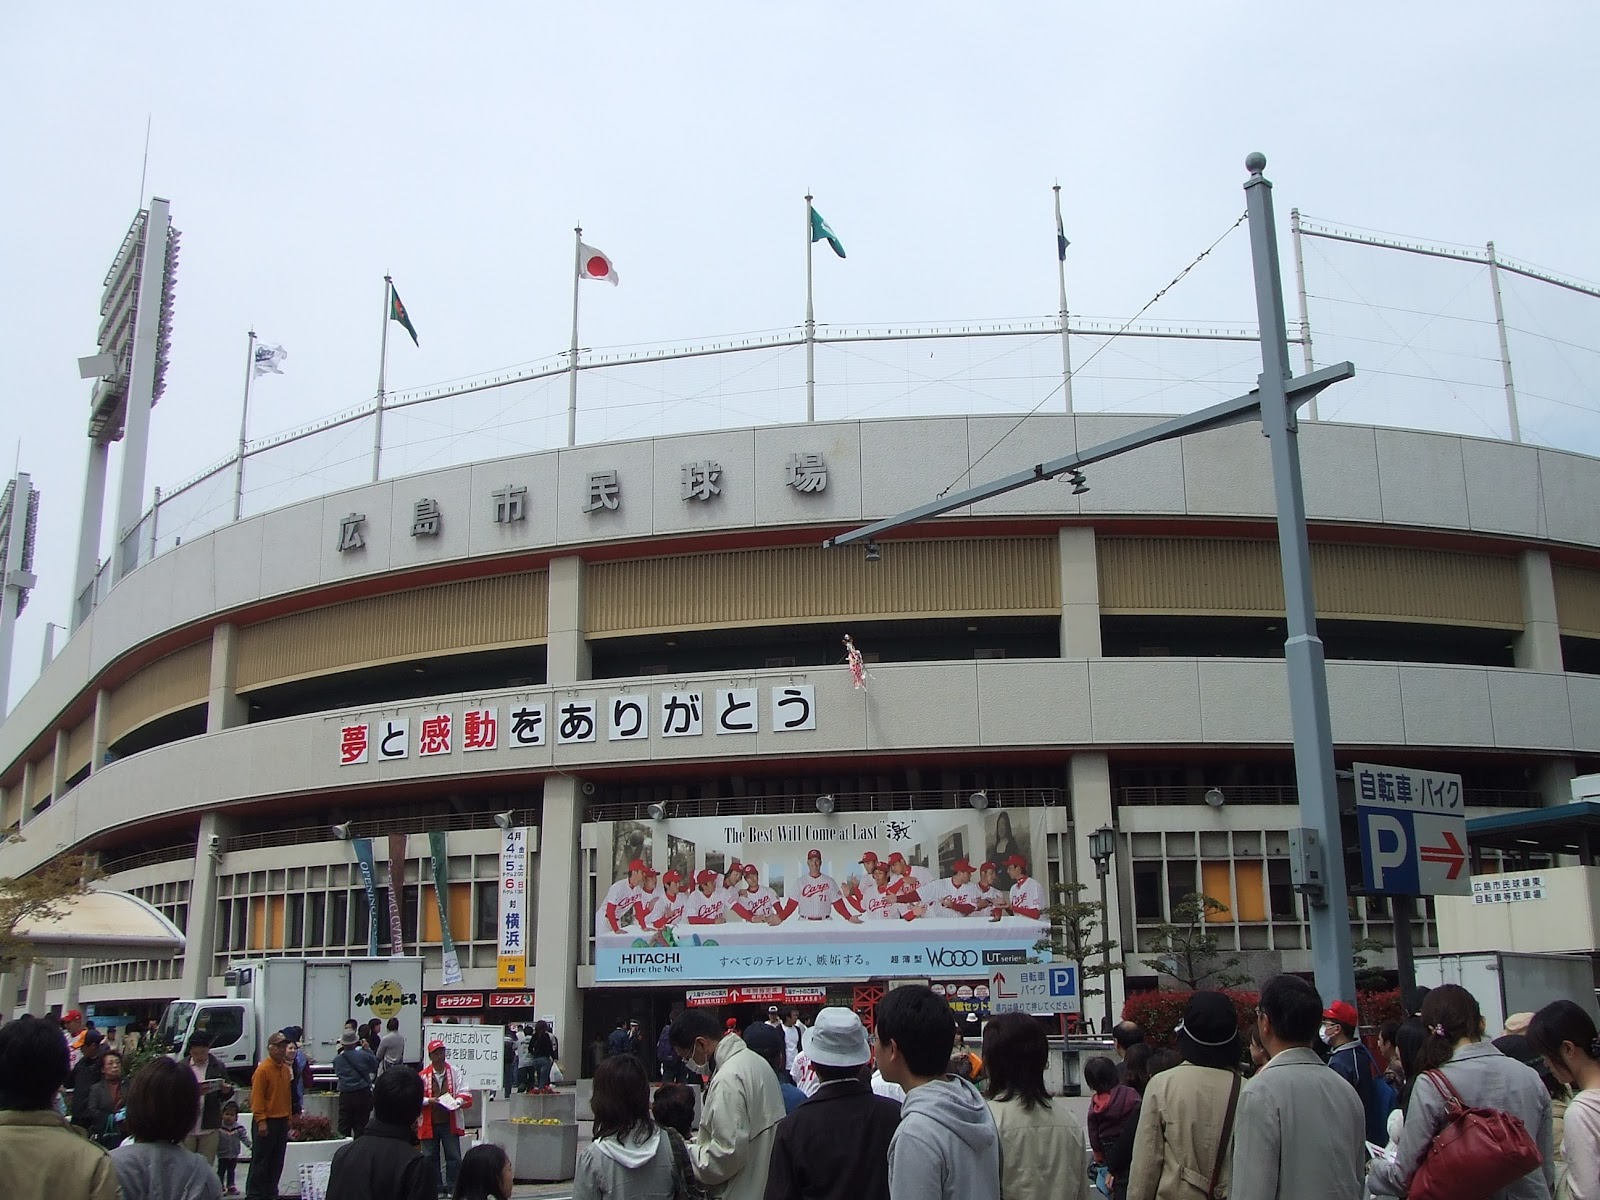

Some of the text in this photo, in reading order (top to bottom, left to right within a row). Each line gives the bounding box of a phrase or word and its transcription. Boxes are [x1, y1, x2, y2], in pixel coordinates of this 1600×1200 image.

[337, 452, 827, 552] 広島市民球場
[341, 690, 810, 764] 夢と感動をありがとう
[507, 832, 521, 841] 4月
[724, 827, 745, 843] The
[749, 826, 774, 843] Best
[777, 825, 801, 842] Will
[805, 825, 836, 842] Come
[839, 827, 849, 840] at
[852, 823, 878, 840] Last
[506, 843, 515, 854] 4
[1368, 814, 1407, 889] P
[506, 861, 514, 871] 5
[505, 879, 514, 889] 6
[802, 883, 830, 898] Carp
[819, 894, 827, 902] 71
[506, 913, 520, 947] 横浜
[622, 953, 680, 965] HITACHI
[891, 955, 922, 964] 超薄型
[986, 953, 1001, 963] UT
[618, 964, 683, 974] Inspire the Next
[1021, 971, 1046, 982] 自転車
[1054, 970, 1069, 994] P
[1021, 984, 1046, 995] バイク
[354, 993, 417, 1007] グルメサービス
[440, 996, 480, 1005] キャラクター
[495, 996, 521, 1005] ショップ
[430, 1033, 491, 1044] この付近において
